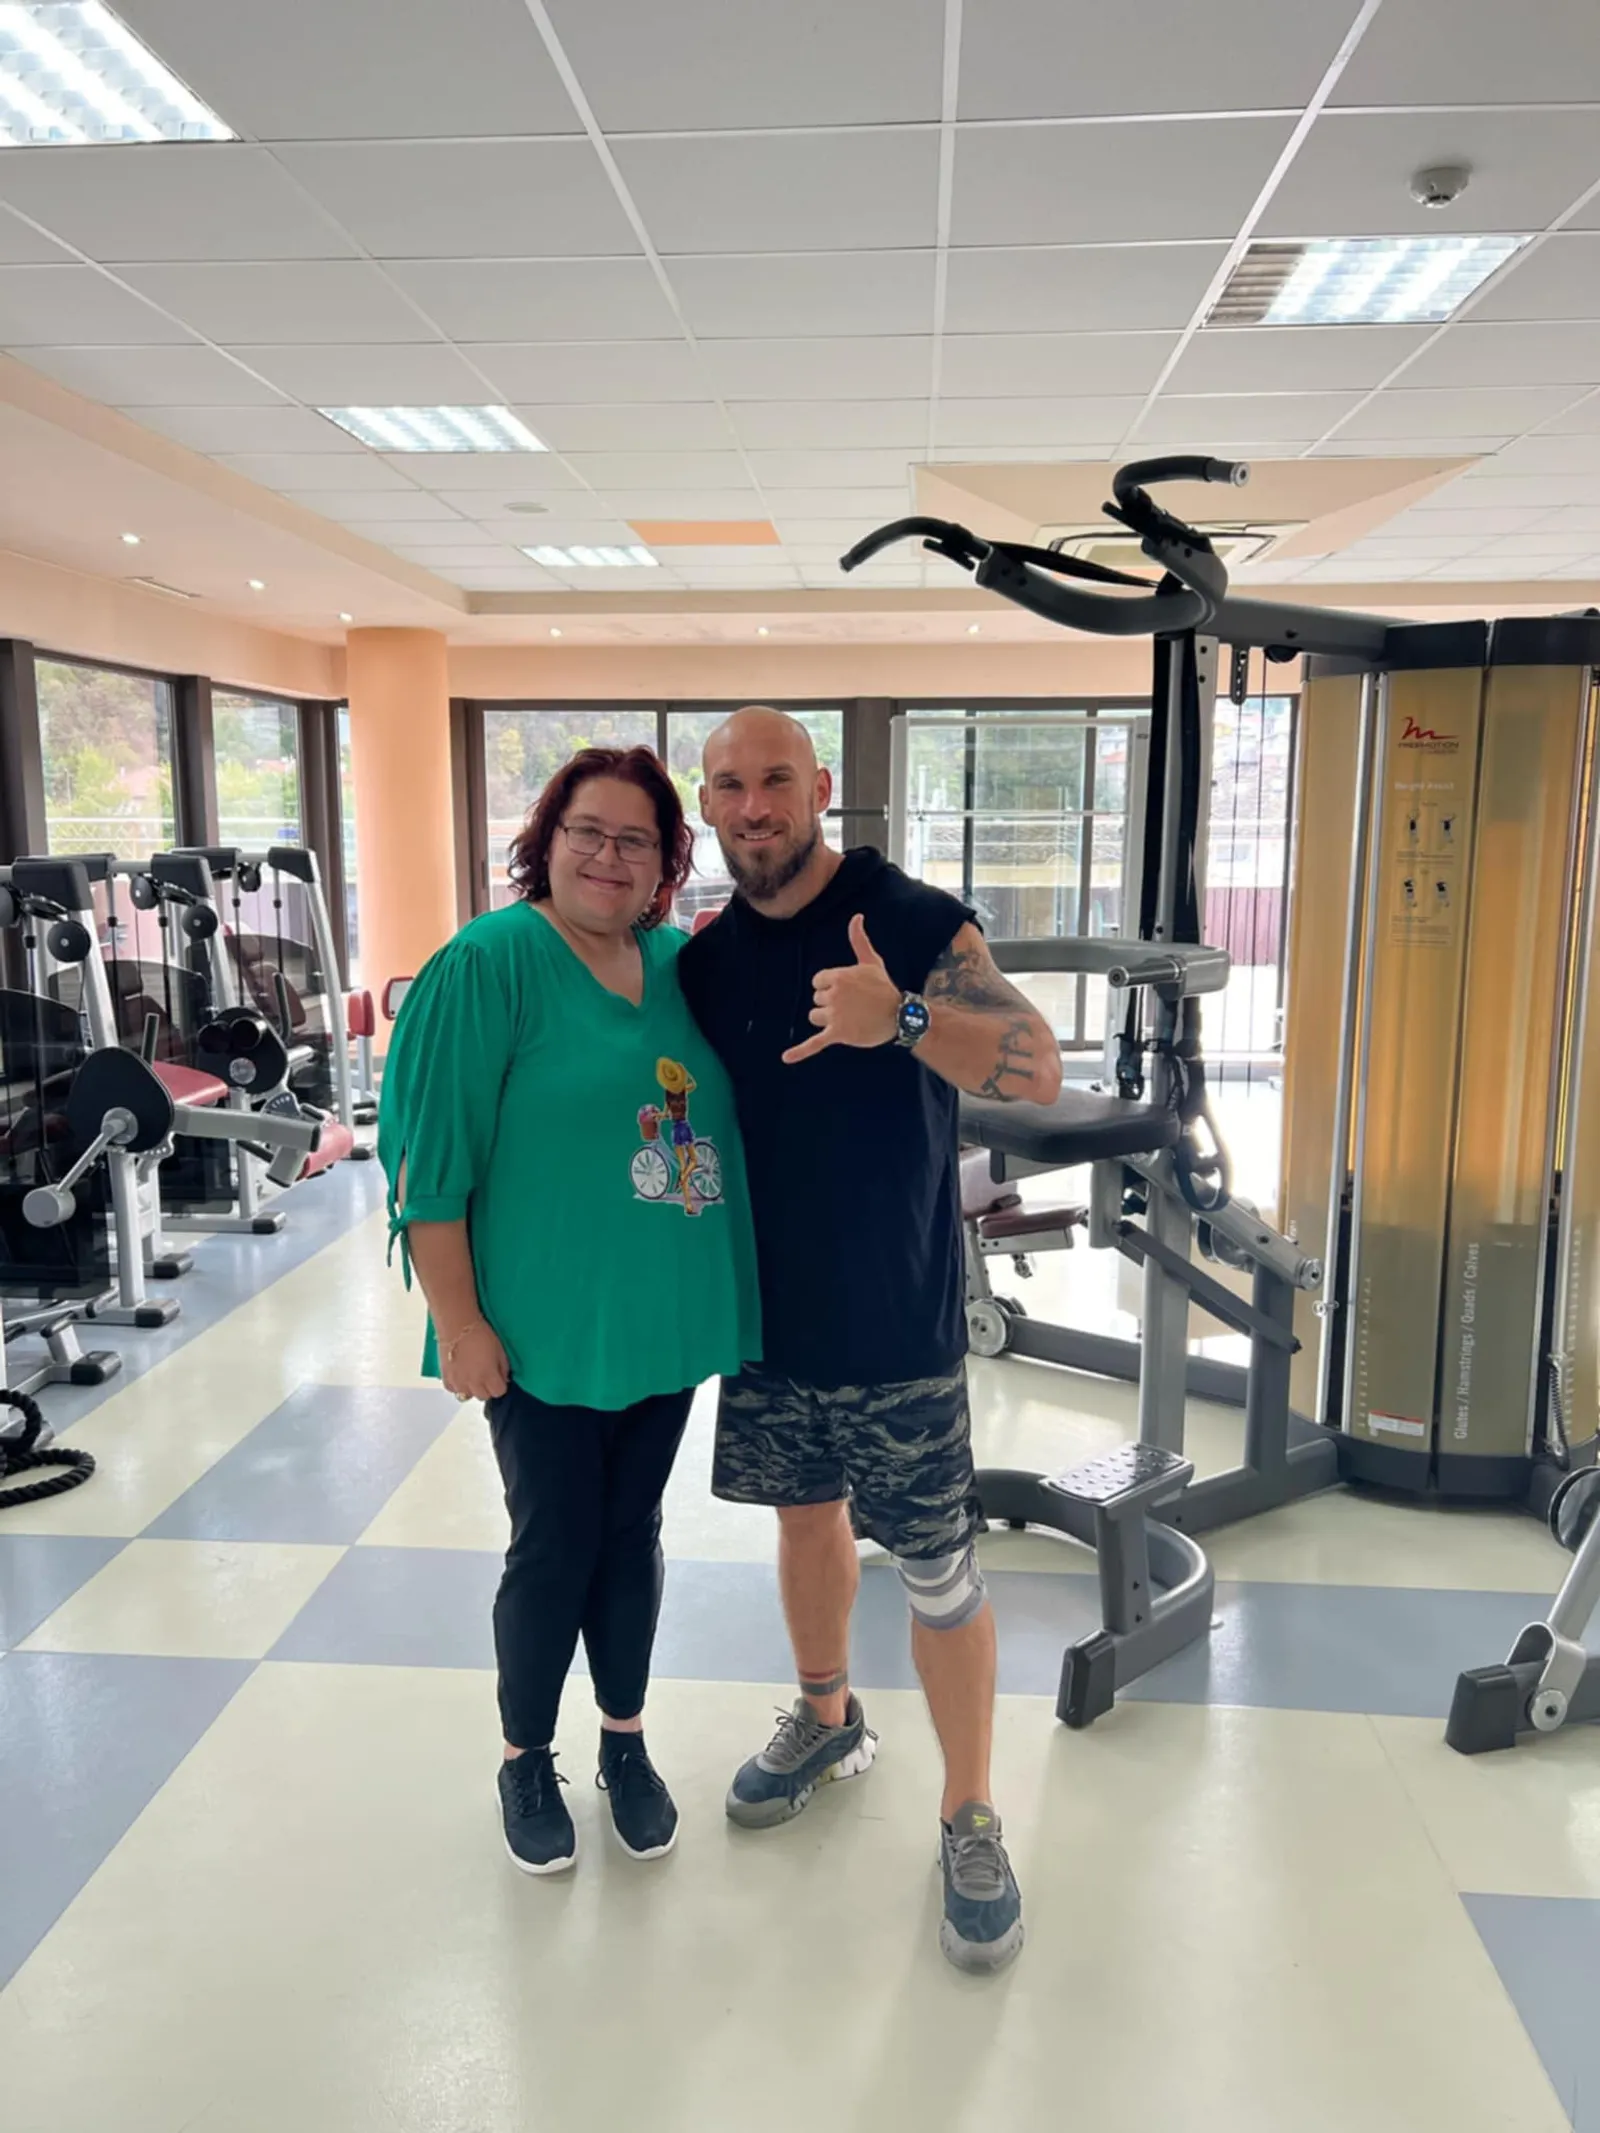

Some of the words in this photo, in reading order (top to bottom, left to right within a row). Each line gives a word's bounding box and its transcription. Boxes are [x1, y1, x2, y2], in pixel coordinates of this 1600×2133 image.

[1464, 1243, 1479, 1279] Calves
[1461, 1289, 1476, 1323] Quads
[1457, 1333, 1475, 1394] Hamstrings
[1454, 1405, 1469, 1439] Glutes
